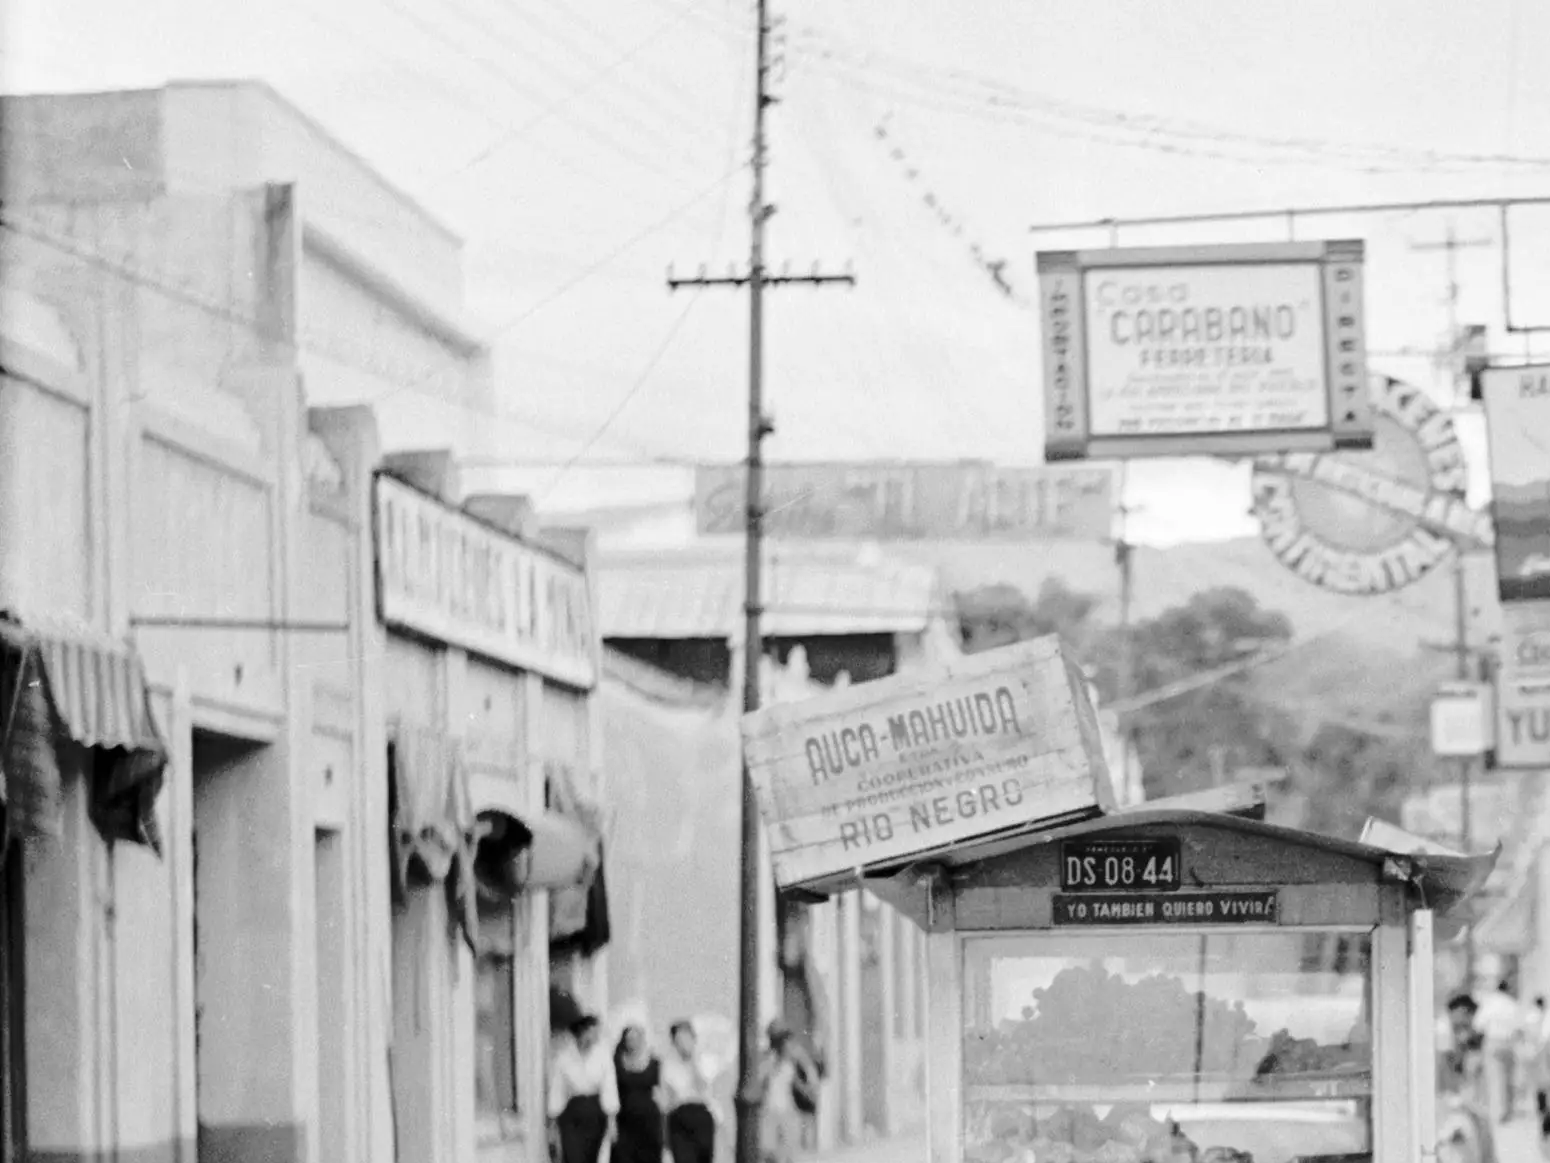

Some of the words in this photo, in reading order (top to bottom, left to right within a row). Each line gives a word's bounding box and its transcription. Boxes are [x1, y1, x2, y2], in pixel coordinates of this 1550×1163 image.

[1096, 280, 1190, 307] Casa
[804, 686, 1022, 786] AUCA-MAHUIDA
[840, 811, 894, 851] RIO
[909, 778, 1024, 833] NEGRO
[1067, 902, 1087, 918] YO
[1093, 901, 1155, 918] TAMBIEN
[1162, 901, 1214, 917] QUIERO
